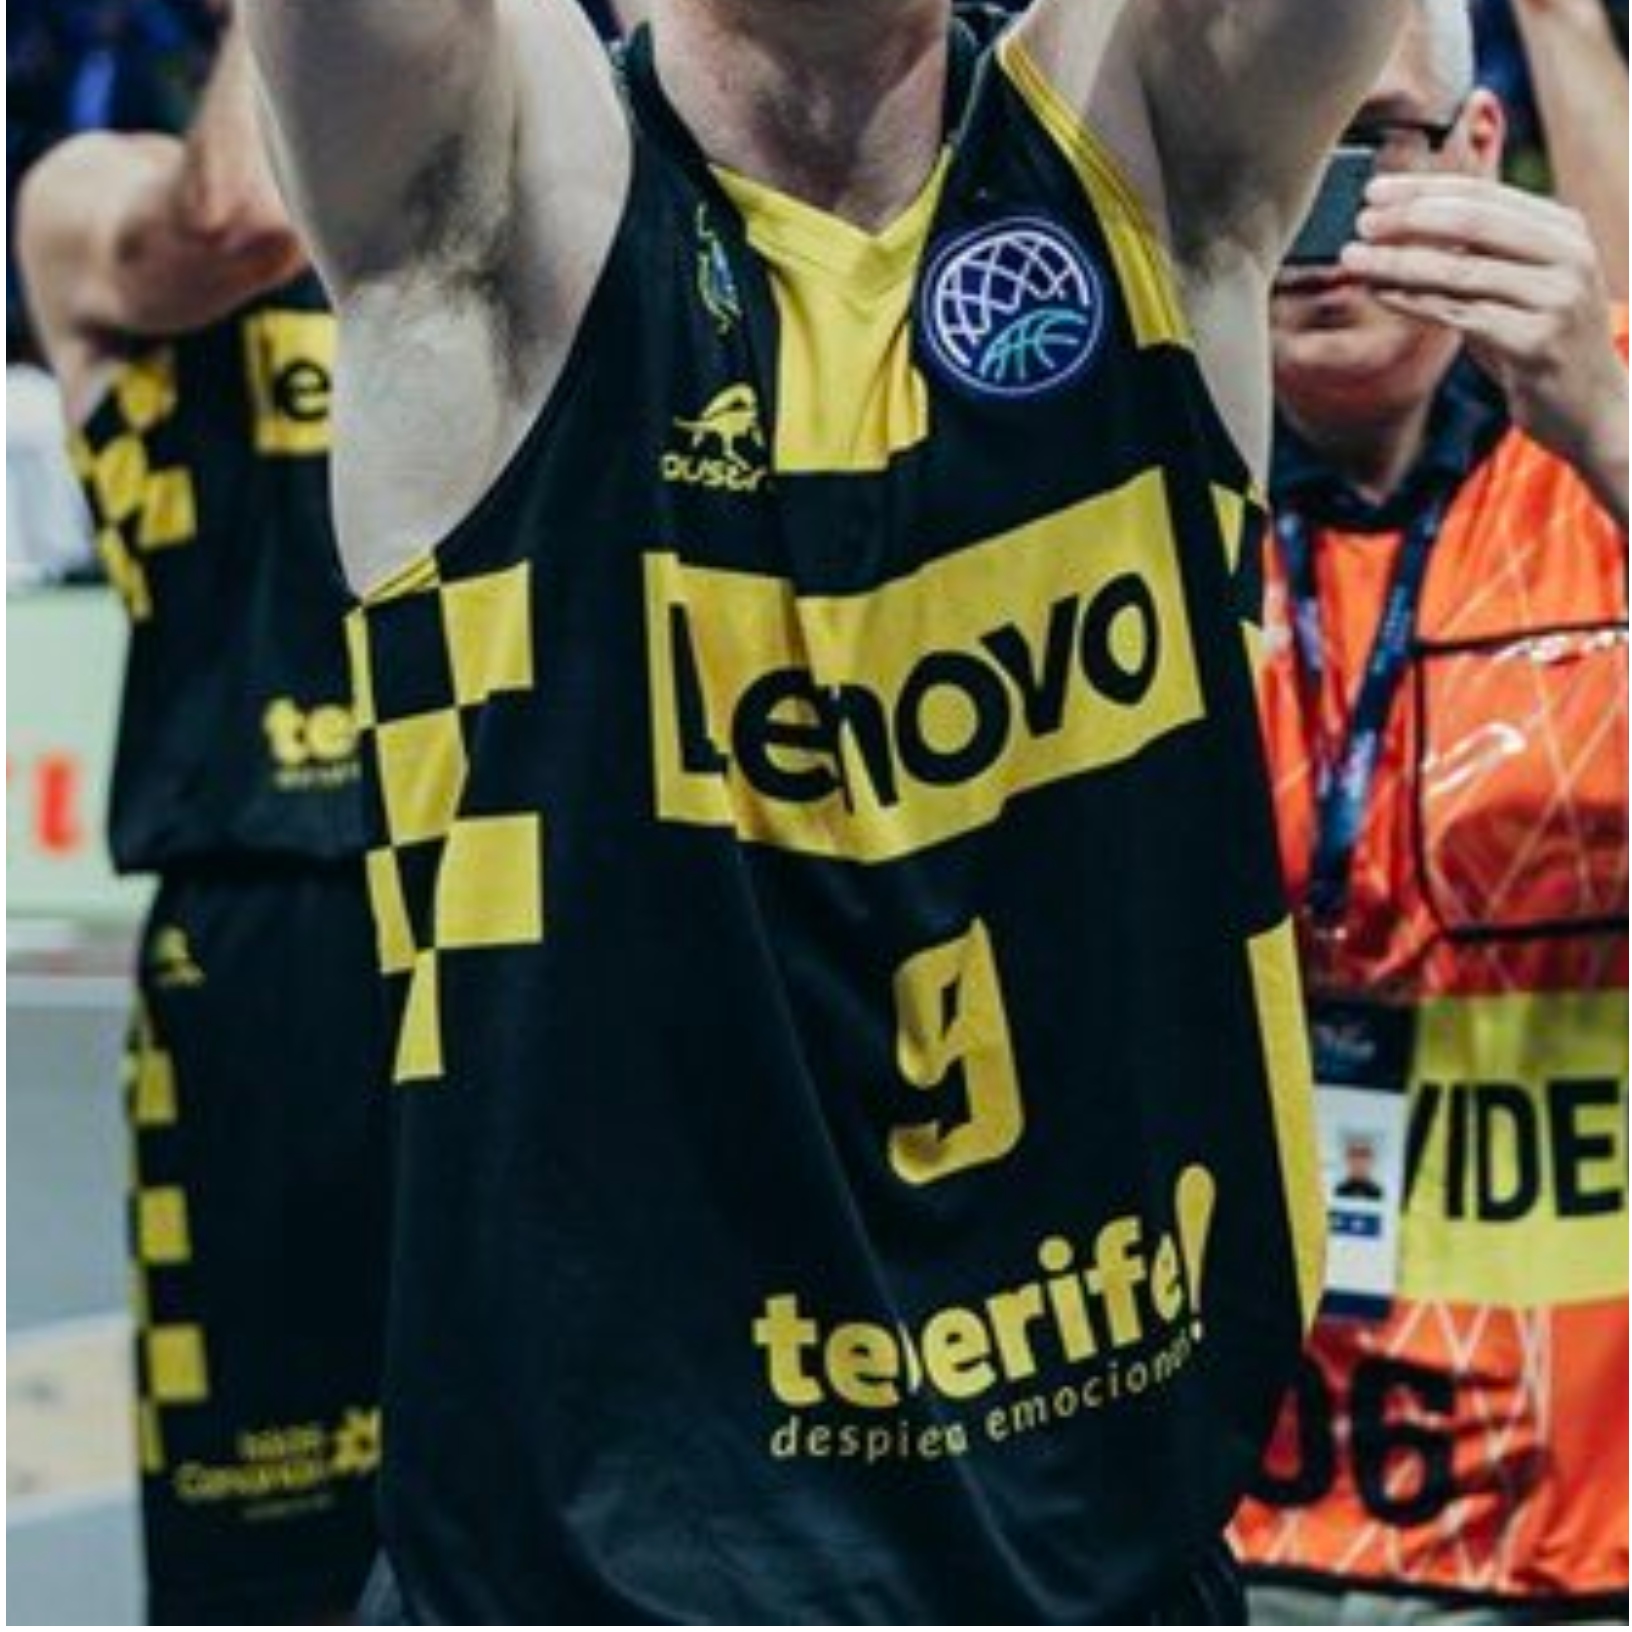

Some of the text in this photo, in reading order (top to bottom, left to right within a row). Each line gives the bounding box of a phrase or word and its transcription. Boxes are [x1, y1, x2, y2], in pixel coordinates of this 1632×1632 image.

[668, 572, 1160, 814] Lenovo
[887, 916, 1025, 1186] 9
[1402, 1079, 1628, 1221] VIDE
[752, 1163, 1216, 1408] teerife!
